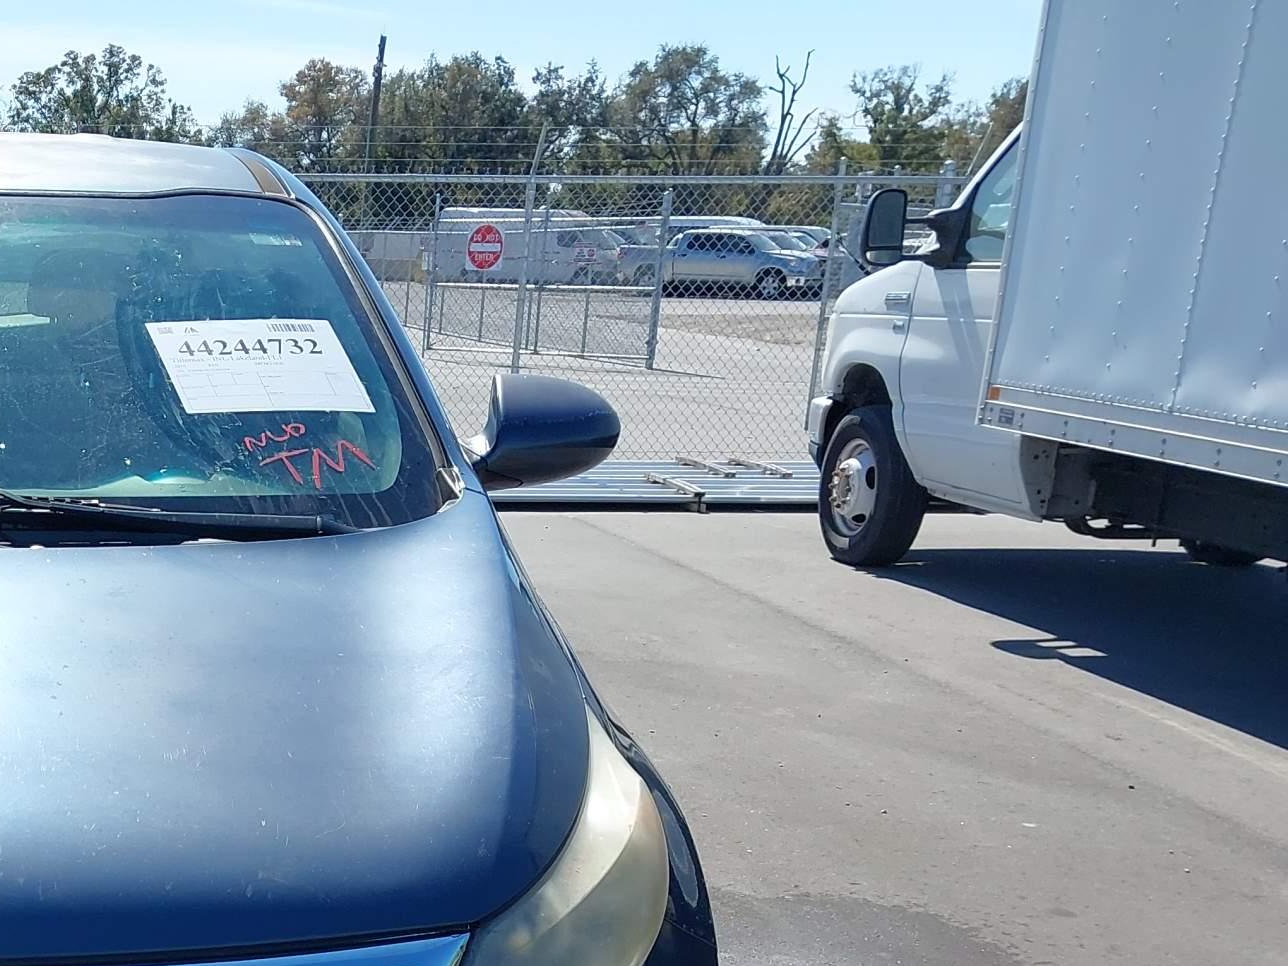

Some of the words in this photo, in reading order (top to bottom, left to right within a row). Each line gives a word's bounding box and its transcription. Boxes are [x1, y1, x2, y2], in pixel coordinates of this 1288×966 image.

[473, 233, 483, 241] DO
[474, 253, 494, 261] ENTER
[178, 338, 323, 356] 44244732
